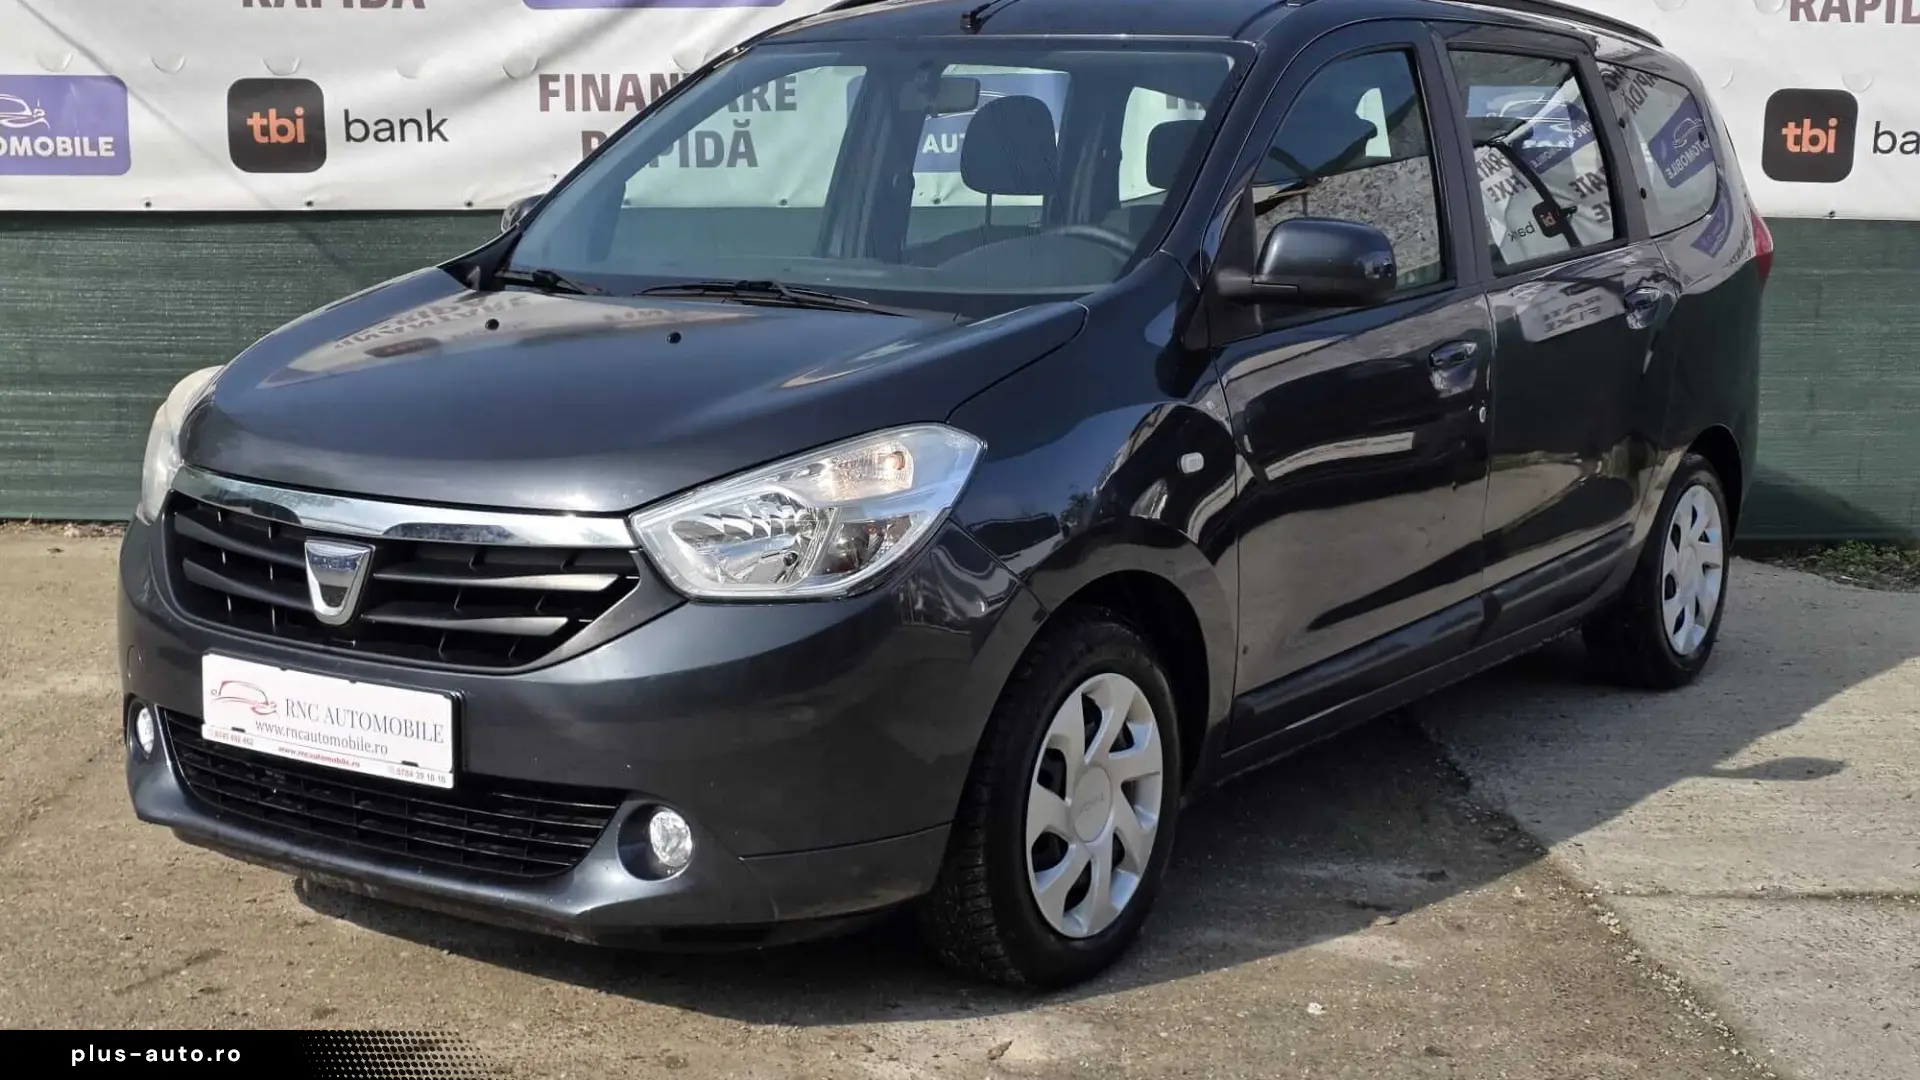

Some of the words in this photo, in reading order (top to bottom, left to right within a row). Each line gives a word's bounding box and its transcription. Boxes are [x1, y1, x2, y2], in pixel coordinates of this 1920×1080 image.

[538, 73, 798, 113] FINANRE
[247, 107, 305, 144] tbi
[344, 108, 449, 143] bank
[1781, 117, 1839, 154] tbi
[255, 719, 389, 756] www.rncautomobile.ro
[285, 698, 320, 722] RNC
[324, 706, 444, 744] AUTOMOBILE
